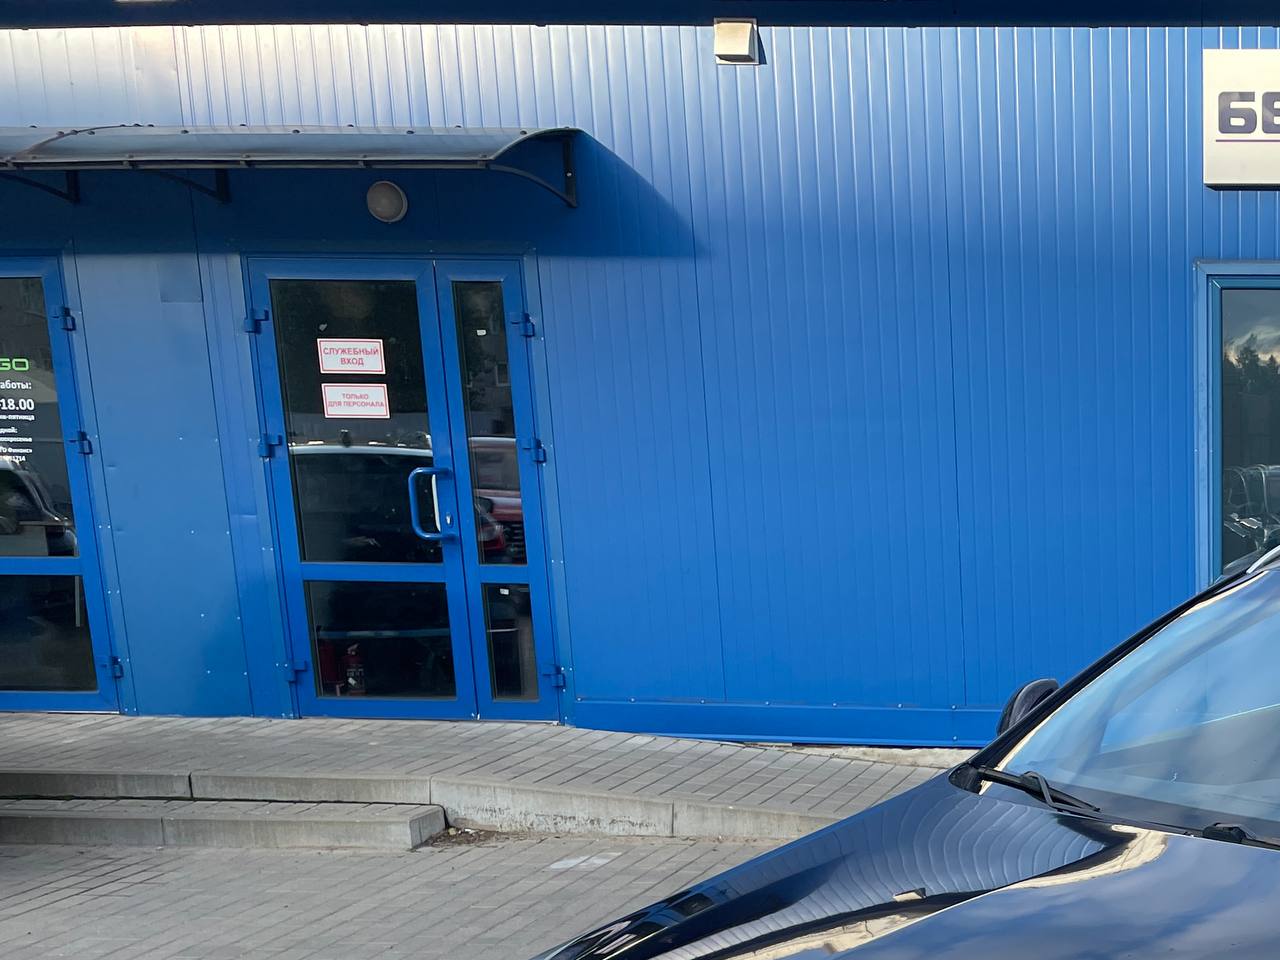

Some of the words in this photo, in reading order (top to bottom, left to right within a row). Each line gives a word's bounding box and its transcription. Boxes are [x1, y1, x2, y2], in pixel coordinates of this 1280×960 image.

[322, 346, 379, 356] СЛУЖЕБНЫЙ
[340, 358, 365, 366] ВХОД
[0, 398, 35, 411] 18.00
